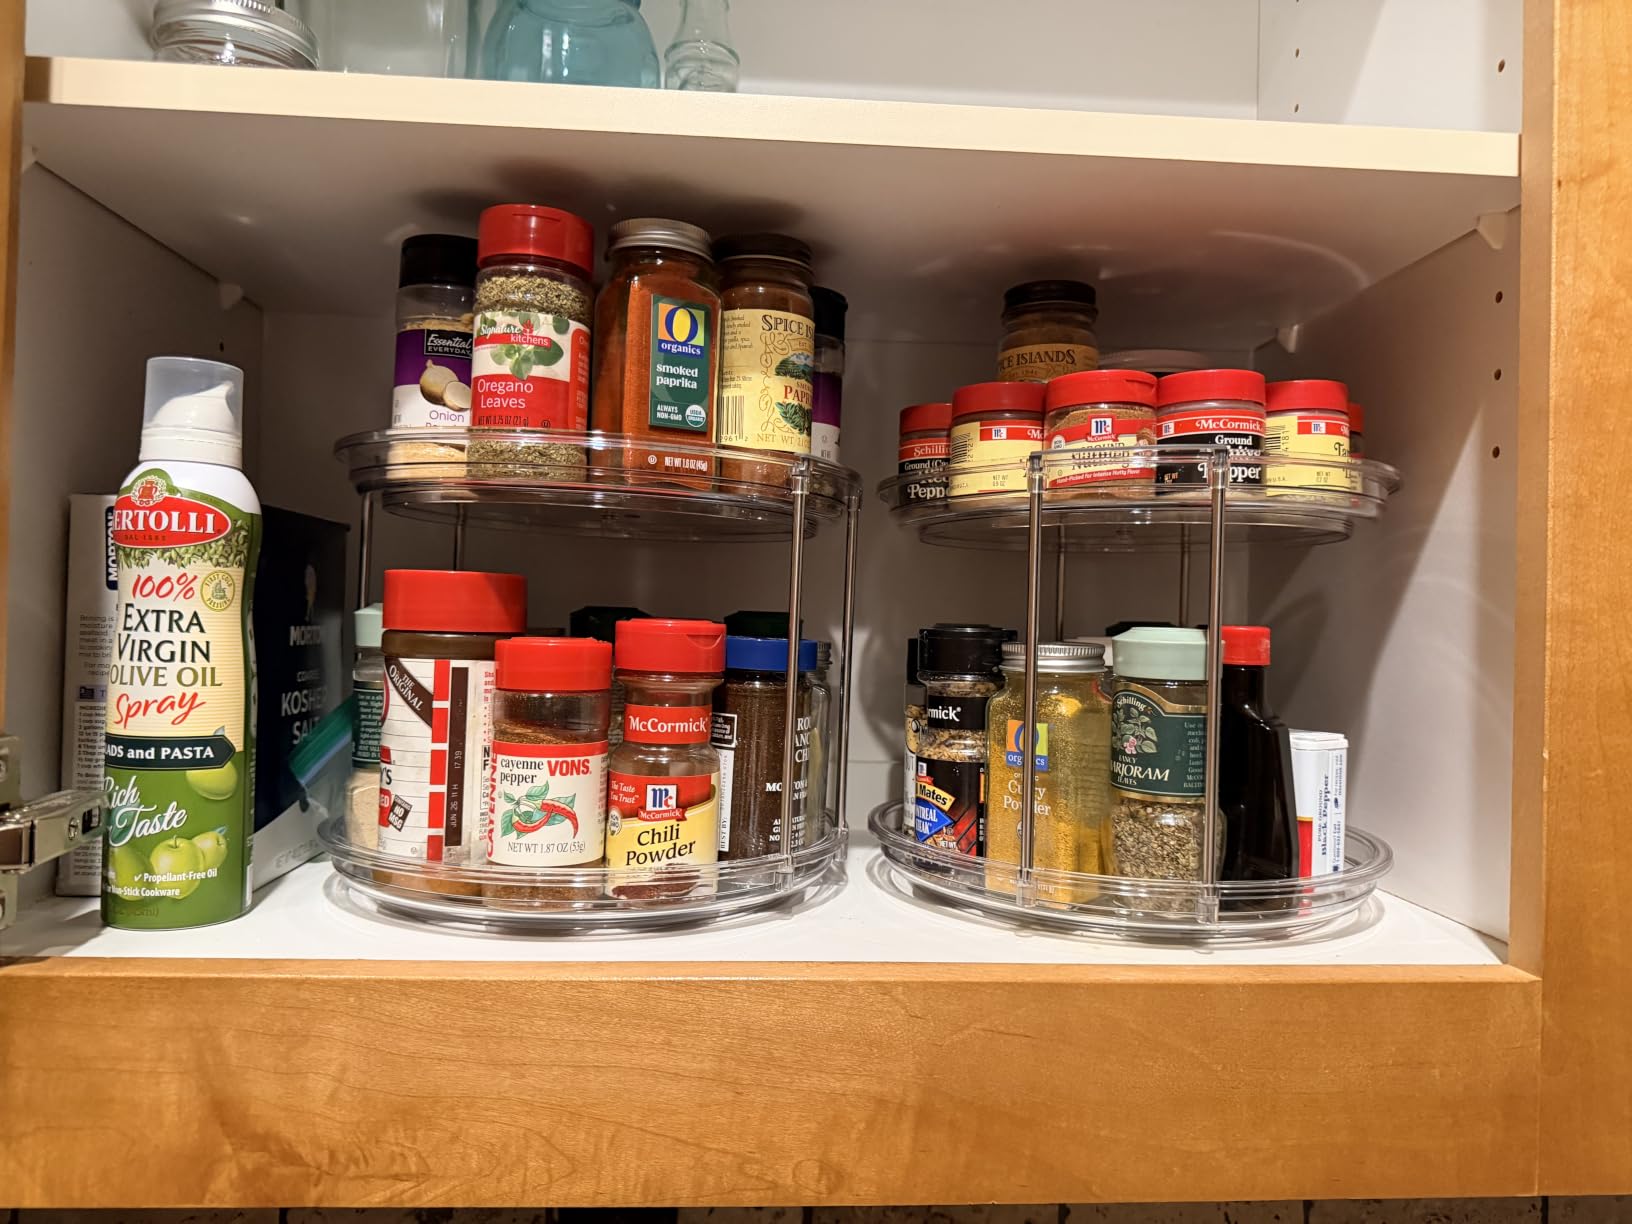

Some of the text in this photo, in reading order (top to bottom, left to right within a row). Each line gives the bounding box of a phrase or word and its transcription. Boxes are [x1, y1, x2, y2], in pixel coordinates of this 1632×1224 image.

[480, 325, 522, 339] Signature
[761, 314, 804, 336] SPICE
[427, 333, 472, 349] Essential
[510, 335, 549, 346] kitchens
[661, 341, 701, 356] organics
[1016, 349, 1076, 366] ISLANDS
[656, 363, 699, 378] smoked
[477, 378, 534, 395] Oregano
[656, 375, 698, 390] paprika
[480, 394, 526, 409] Leaves
[656, 404, 678, 413] ALWAYS
[429, 409, 464, 423] Onion
[656, 412, 682, 421] NON-GMO
[1195, 418, 1261, 430] McCormick
[756, 433, 776, 443] NET
[781, 435, 794, 444] WT
[1215, 435, 1253, 445] Ground
[664, 456, 674, 467] NET
[674, 457, 682, 468] WT
[682, 458, 690, 469] 1.6
[690, 459, 697, 470] OZ
[904, 460, 930, 471] Ground
[132, 572, 198, 602] 100%
[122, 603, 206, 634] EXTRA
[117, 633, 211, 664] VIRGIN
[109, 664, 168, 687] OLIVE
[176, 666, 223, 688] OIL
[402, 673, 415, 690] THE
[389, 664, 423, 711] ORIGINAL
[114, 692, 207, 729] Spray
[1116, 695, 1146, 711] Schilling
[629, 715, 707, 734] McCormick
[126, 747, 155, 760] and
[160, 746, 215, 760] PASTA
[454, 750, 462, 761] 39
[500, 758, 590, 776] cayenne VONS
[500, 771, 537, 786] pepper
[611, 780, 636, 793] The Taste
[610, 791, 635, 804] You Trust
[919, 783, 948, 806] Mates
[394, 804, 404, 818] NO
[450, 800, 458, 811] 26
[389, 812, 403, 828] MSG
[640, 809, 682, 820] McCormick
[1321, 774, 1331, 856] Black Pepper
[109, 801, 187, 848] Taste
[637, 823, 680, 846] Chili
[507, 841, 586, 854] NET WT 1.87 OZ (53g)
[625, 840, 697, 866] Powder
[143, 867, 218, 885] Propellant-Free Oil
[140, 887, 181, 897] Cookware
